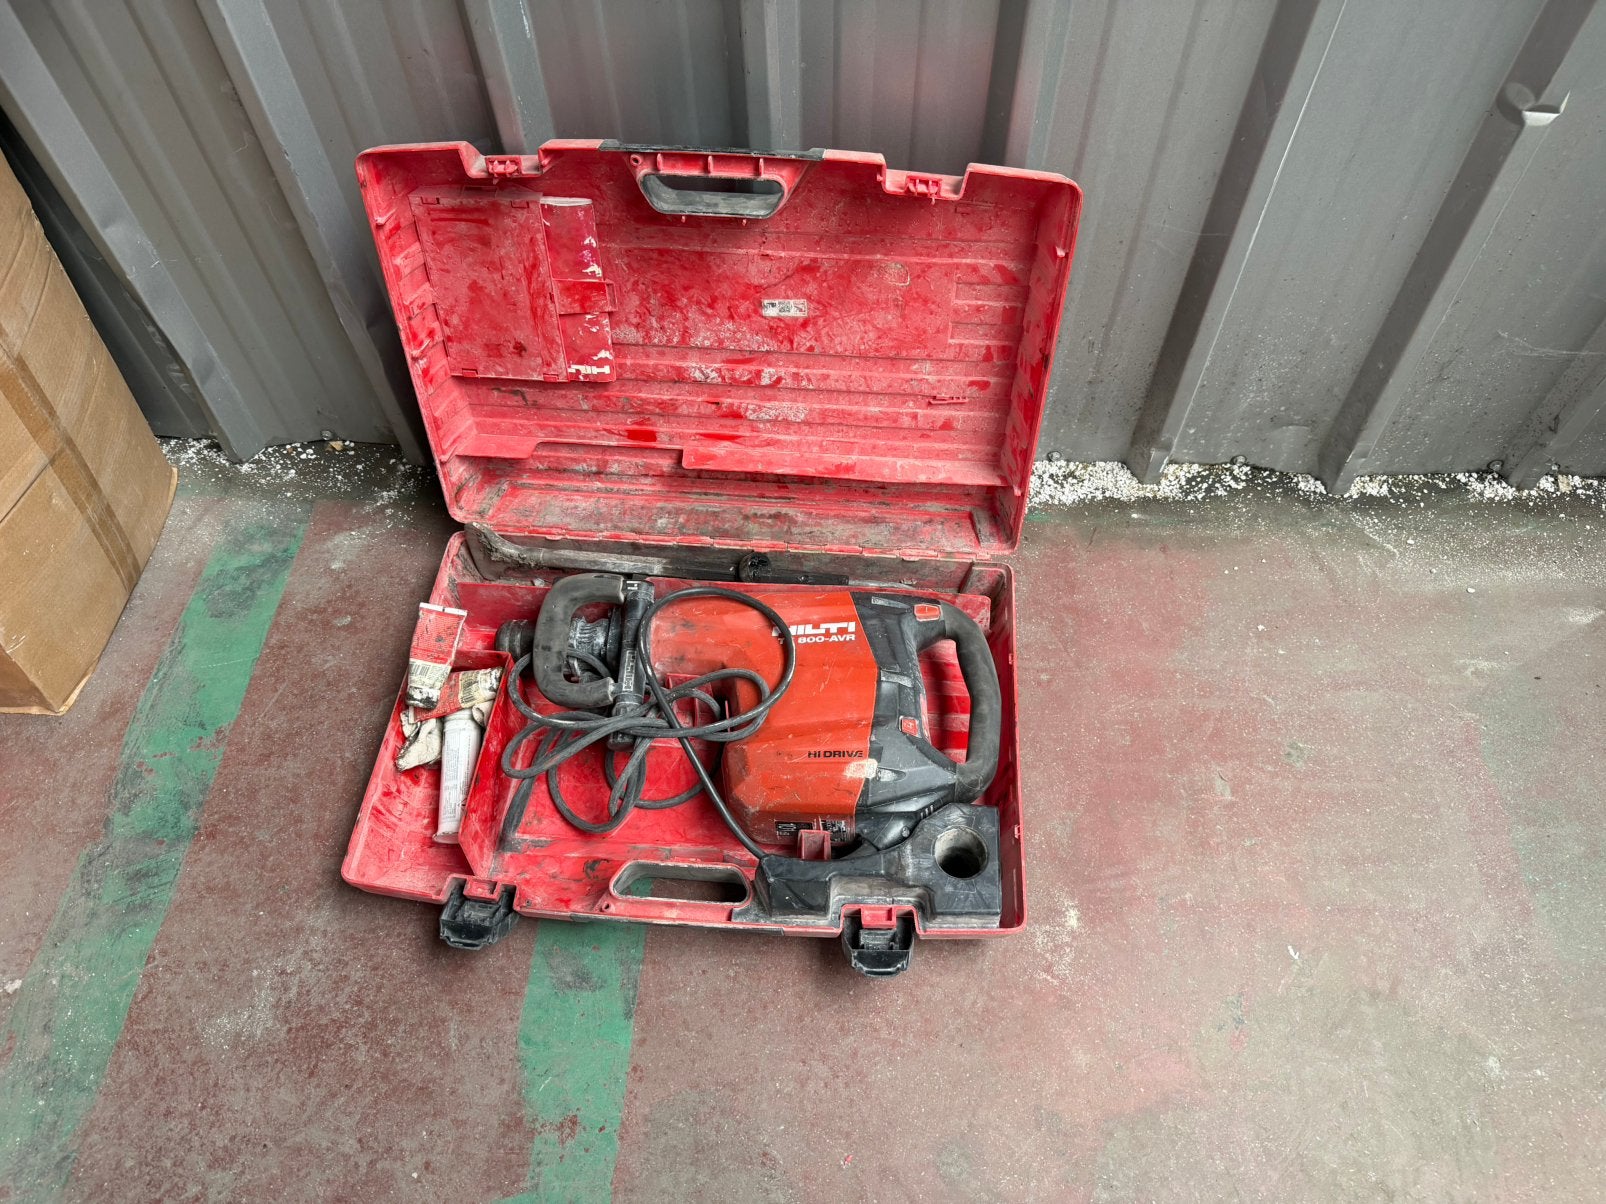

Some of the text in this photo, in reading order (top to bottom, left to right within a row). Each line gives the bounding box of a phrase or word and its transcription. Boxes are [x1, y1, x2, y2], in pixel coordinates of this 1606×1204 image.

[797, 634, 856, 644] 800-AVR
[807, 750, 863, 758] HI DRIVE
